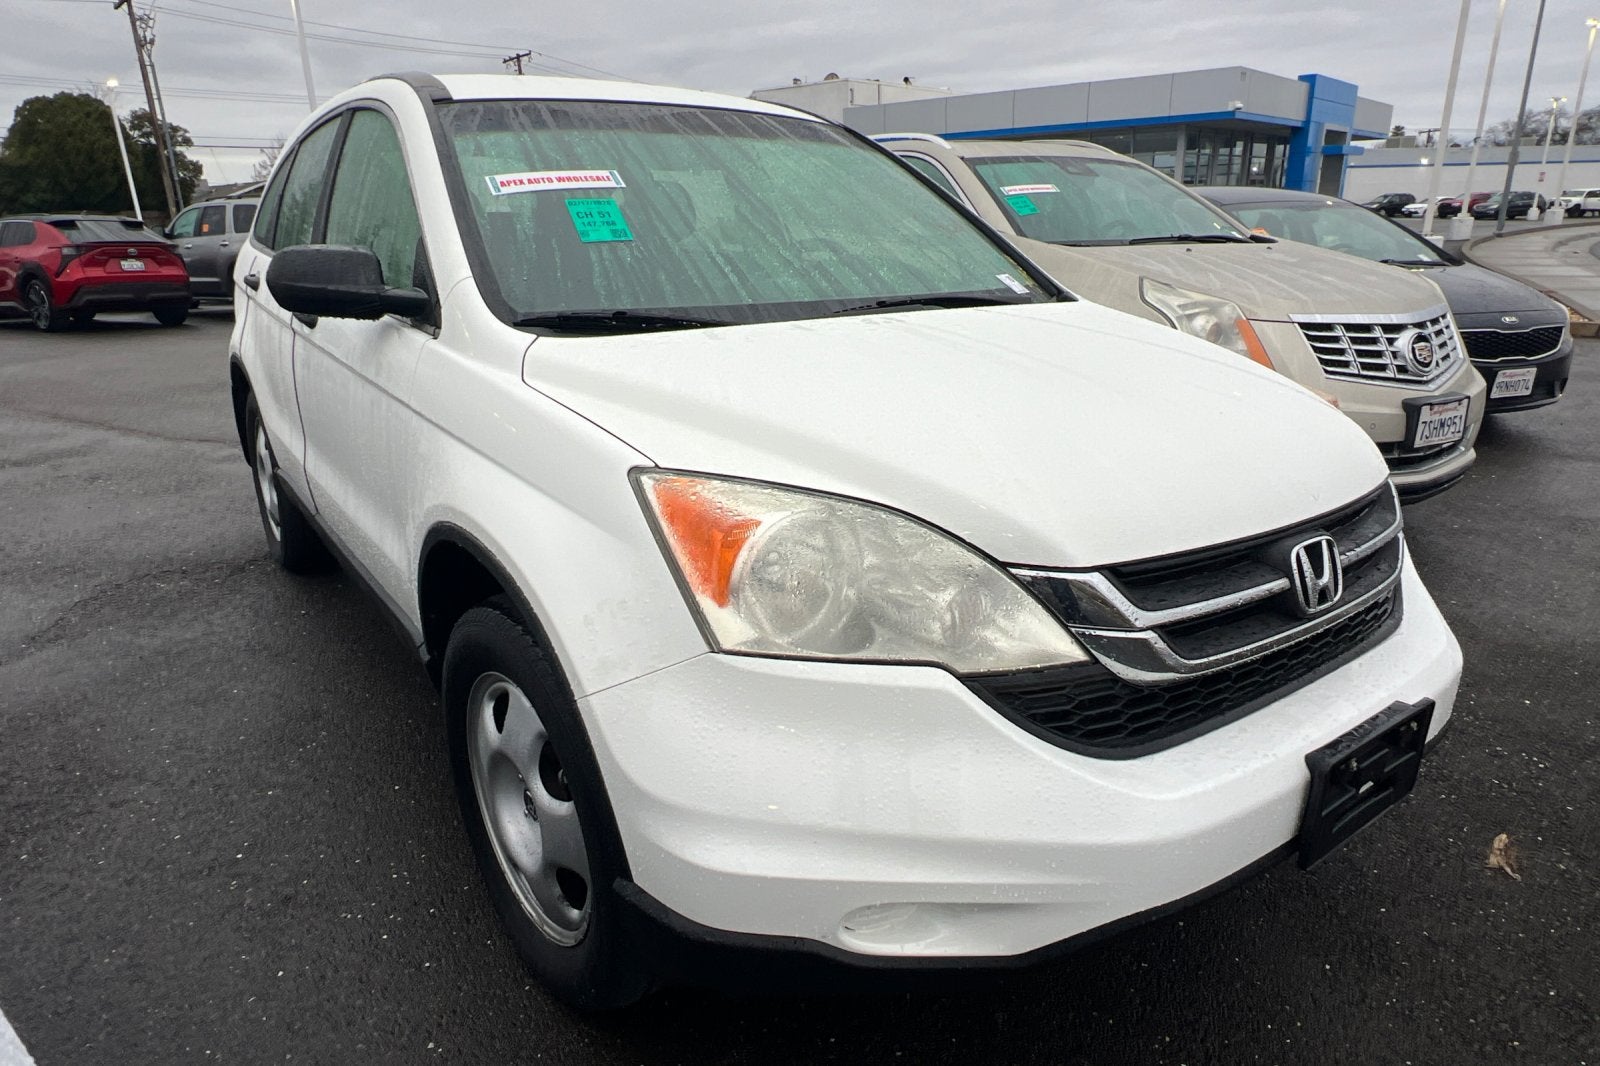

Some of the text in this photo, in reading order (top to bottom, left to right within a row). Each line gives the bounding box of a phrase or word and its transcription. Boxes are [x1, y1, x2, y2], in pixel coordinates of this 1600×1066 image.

[499, 174, 613, 188] APEX AUTO WHOLESALE
[575, 211, 594, 219] CH
[1419, 415, 1463, 441] 7SHM951
